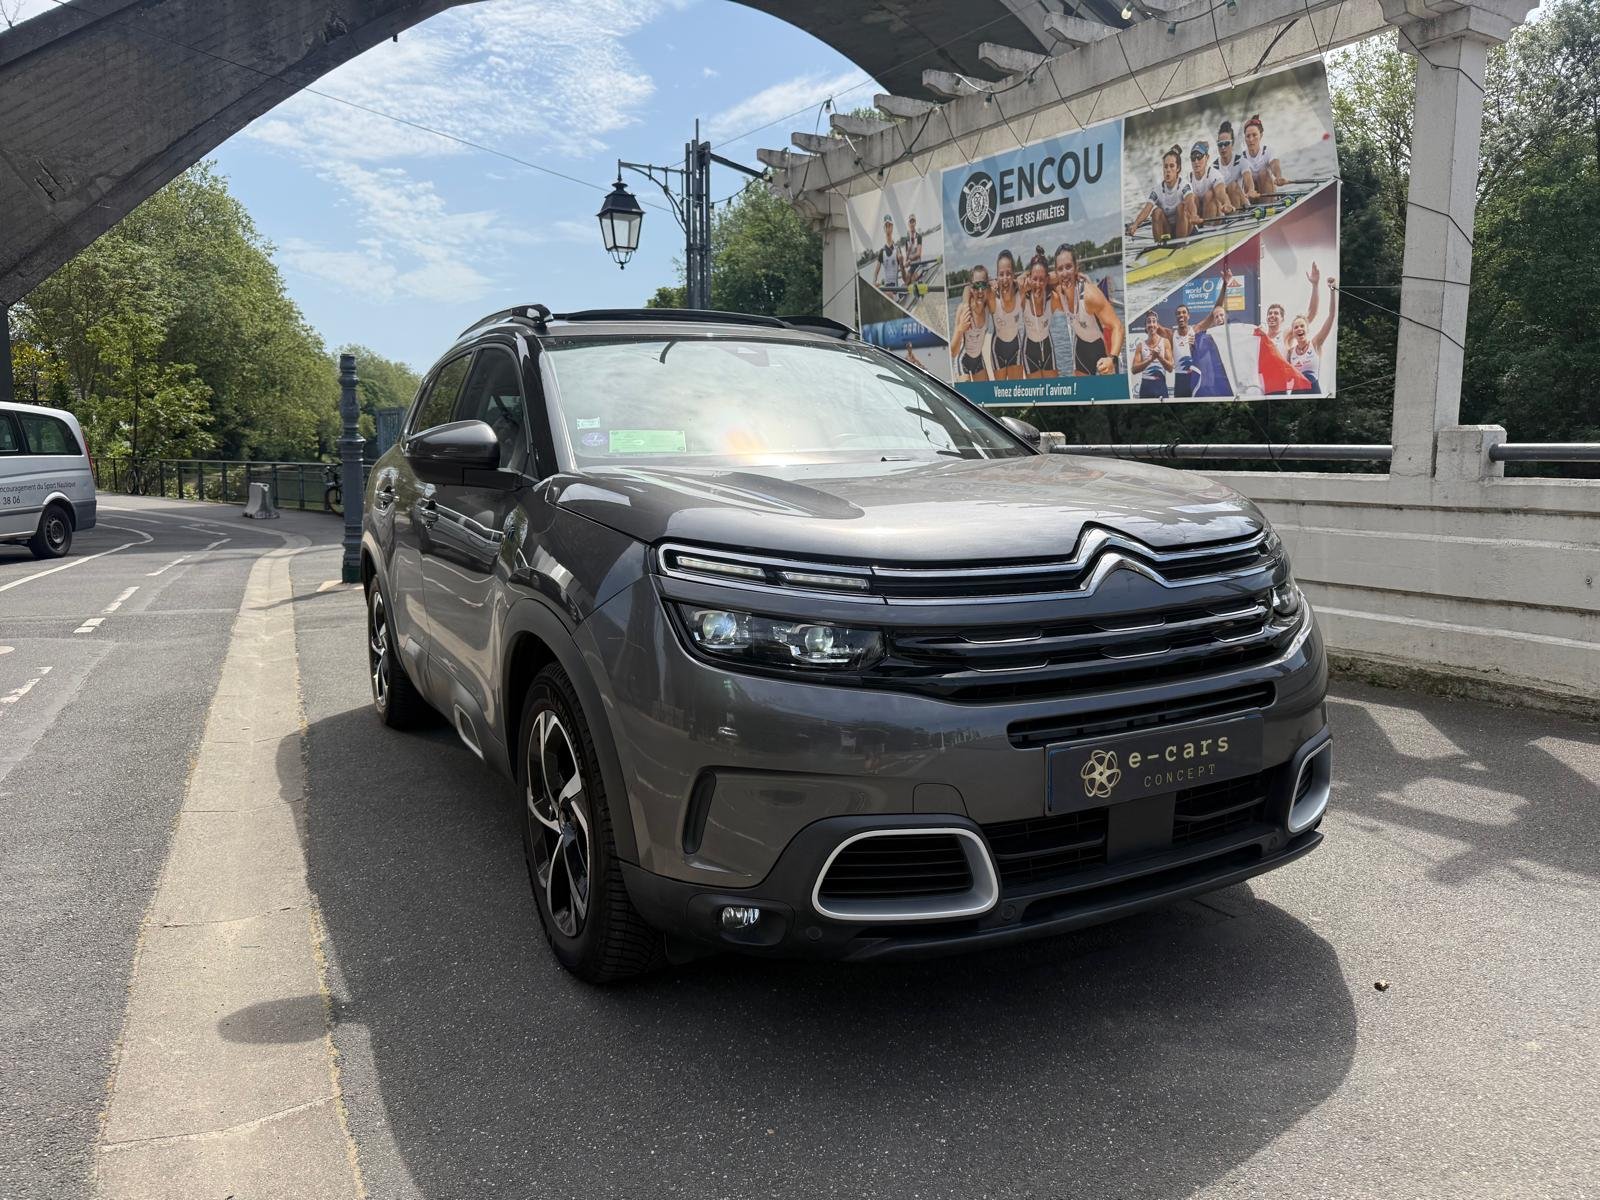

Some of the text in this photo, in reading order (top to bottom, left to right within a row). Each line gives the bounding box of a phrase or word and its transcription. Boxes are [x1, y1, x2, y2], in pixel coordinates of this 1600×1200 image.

[1000, 143, 1103, 205] ENCOU
[1001, 204, 1065, 230] FIER DE SES ATHLÈTES
[994, 382, 1077, 397] Venez découvrir l'aviron !
[3, 495, 21, 505] 38 06
[1128, 736, 1229, 769] e-cars
[1144, 764, 1216, 788] CONCEPT
